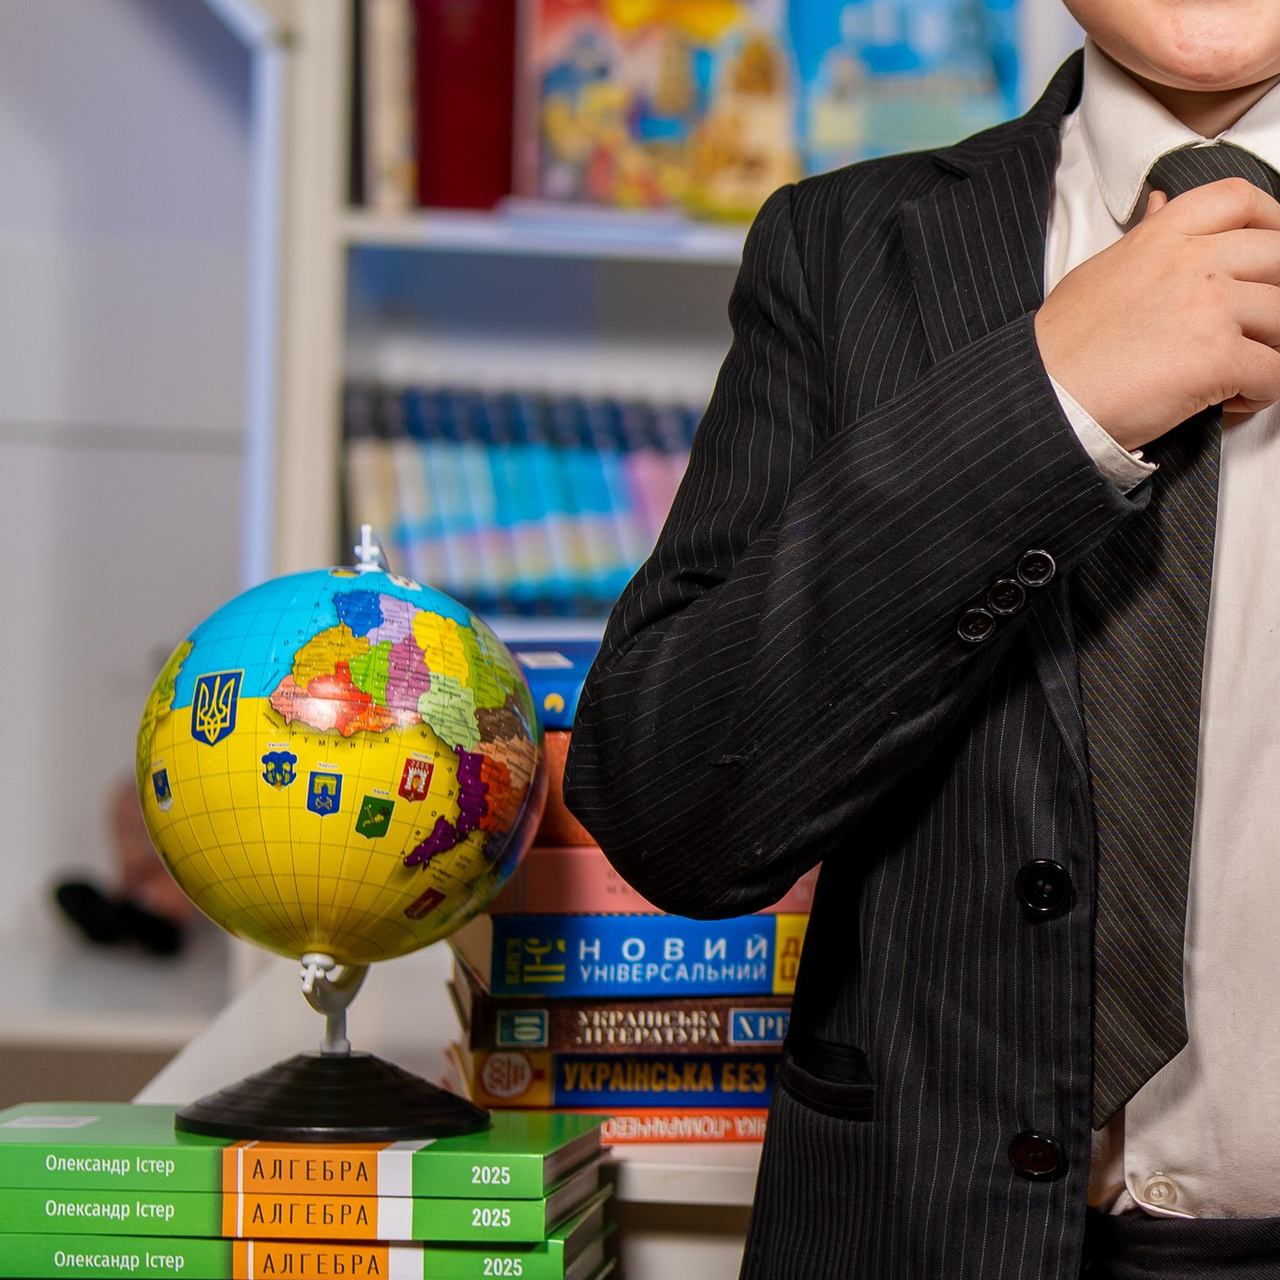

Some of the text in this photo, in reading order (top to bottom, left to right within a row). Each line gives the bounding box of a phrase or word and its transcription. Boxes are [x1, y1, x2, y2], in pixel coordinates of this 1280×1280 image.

[579, 933, 768, 961] НОВИЙ
[580, 962, 767, 983] УНІВЕРСАЛЬНИЙ
[575, 1027, 720, 1045] ЛІТЕРАТУРА
[564, 1060, 714, 1092] УКРАЇНСЬКА
[721, 1062, 767, 1093] БЕЗ
[46, 1155, 510, 1184] Олександр Істер АЛГЕБРА 2025
[46, 1200, 511, 1226] Олександр Істер АЛГЕБРА 2025
[55, 1251, 522, 1276] Олександр Істер АЛГЕБРА 2025
